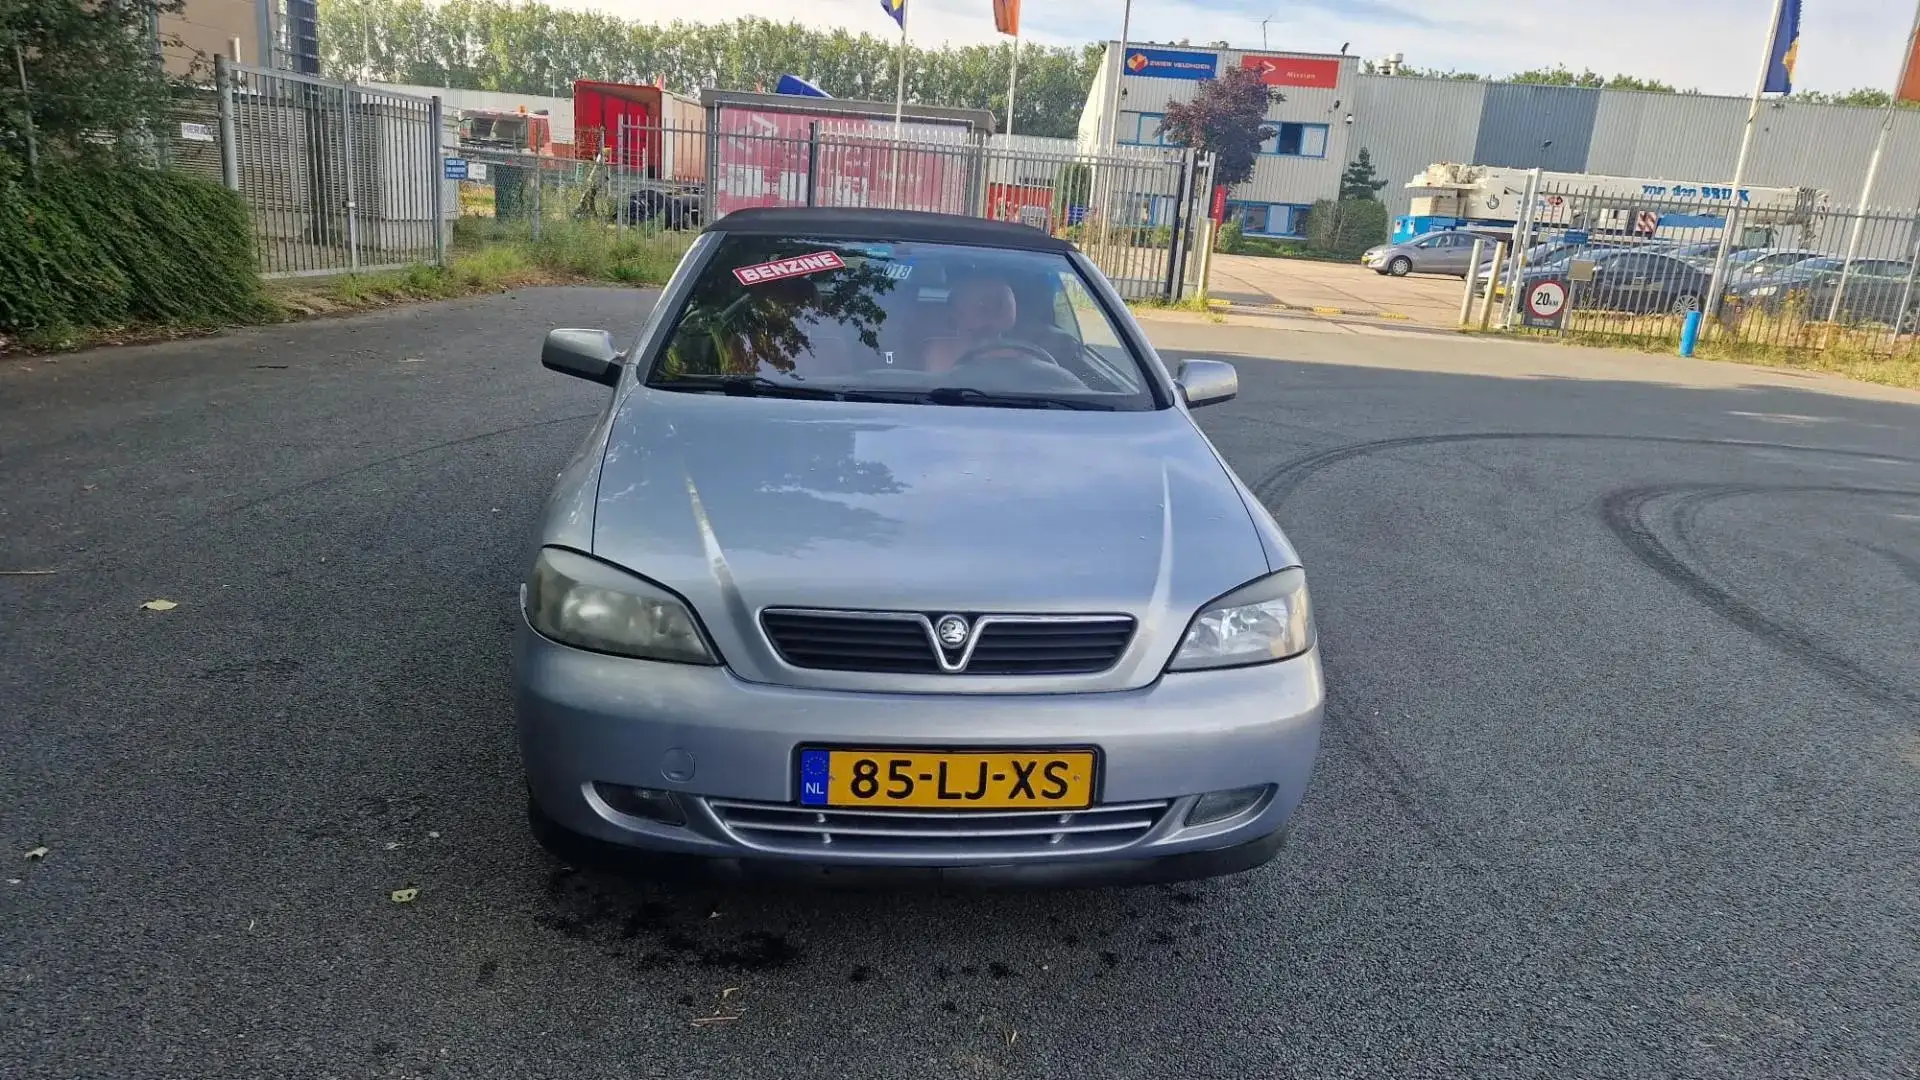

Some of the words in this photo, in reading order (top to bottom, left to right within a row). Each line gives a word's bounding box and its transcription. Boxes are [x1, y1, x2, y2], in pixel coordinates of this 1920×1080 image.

[1286, 71, 1316, 79] Mission
[1642, 184, 1666, 196] van
[1673, 184, 1697, 197] den
[741, 253, 838, 281] BENZINE
[1535, 292, 1550, 306] 20
[850, 759, 1069, 800] 85-LJ-XS
[805, 782, 824, 795] NL
